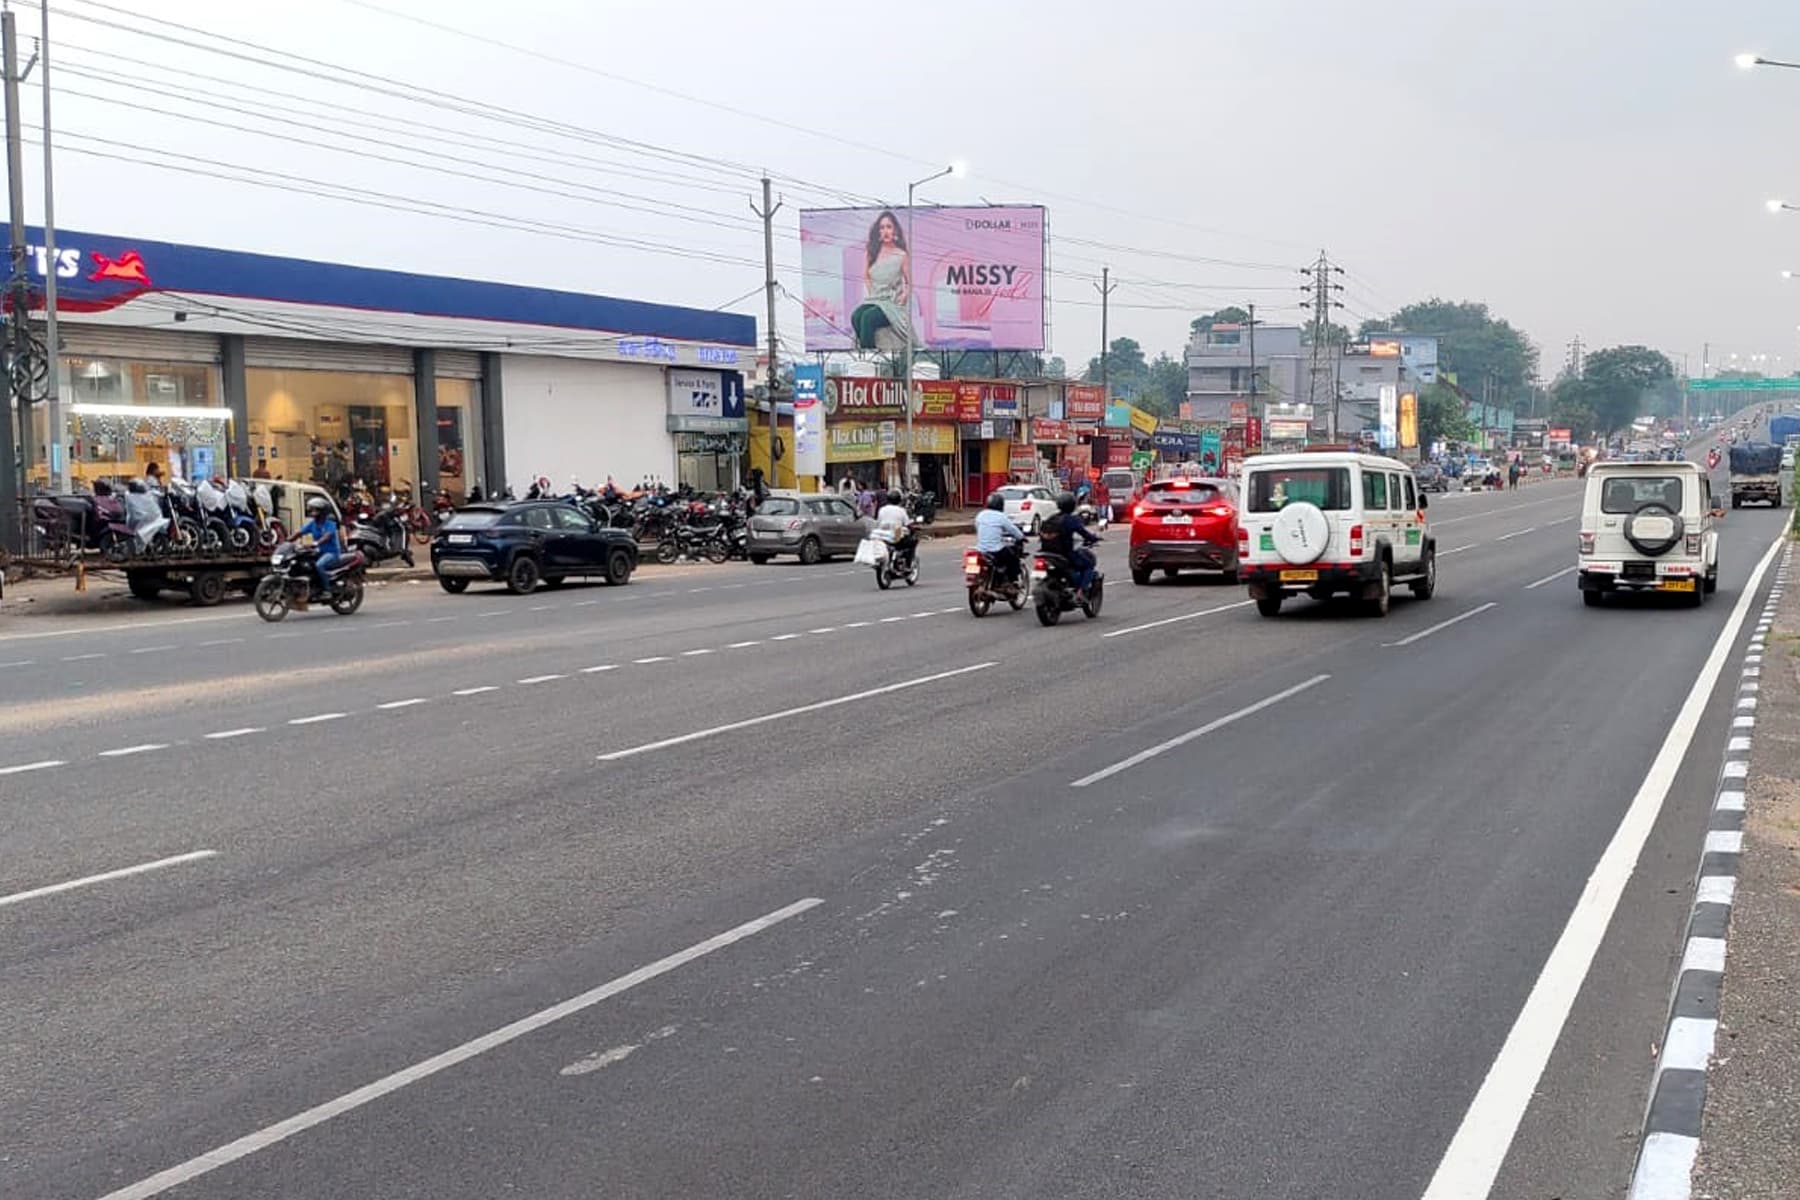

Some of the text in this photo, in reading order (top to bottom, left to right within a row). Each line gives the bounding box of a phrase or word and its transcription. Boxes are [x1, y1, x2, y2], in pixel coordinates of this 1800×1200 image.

[973, 219, 1012, 229] DOLLAR
[946, 265, 1017, 285] MISSY
[841, 380, 908, 412] Hot Chilly
[832, 429, 850, 445] Hot
